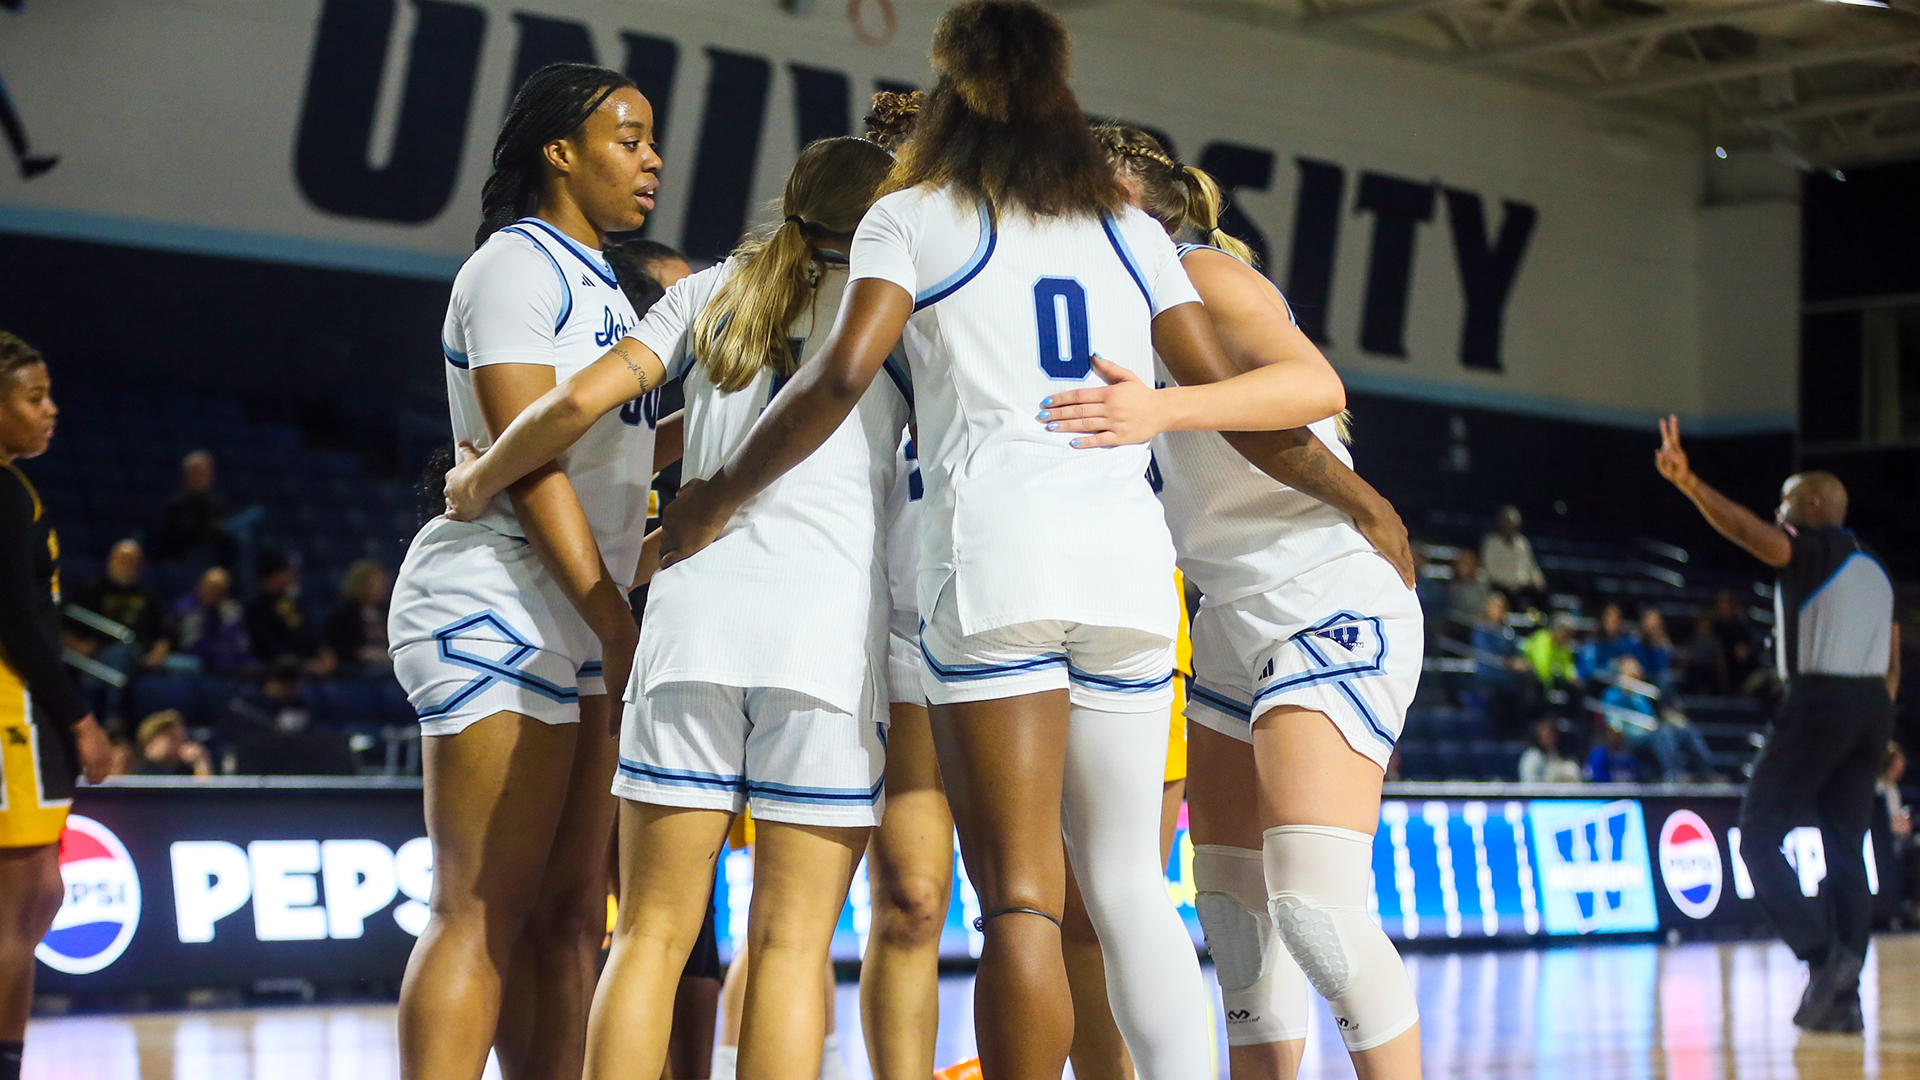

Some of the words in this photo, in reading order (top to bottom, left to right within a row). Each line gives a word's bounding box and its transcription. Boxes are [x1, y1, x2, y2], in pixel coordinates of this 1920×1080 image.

[1031, 274, 1092, 382] 0
[71, 882, 126, 905] PSI
[170, 837, 434, 943] PEPS
